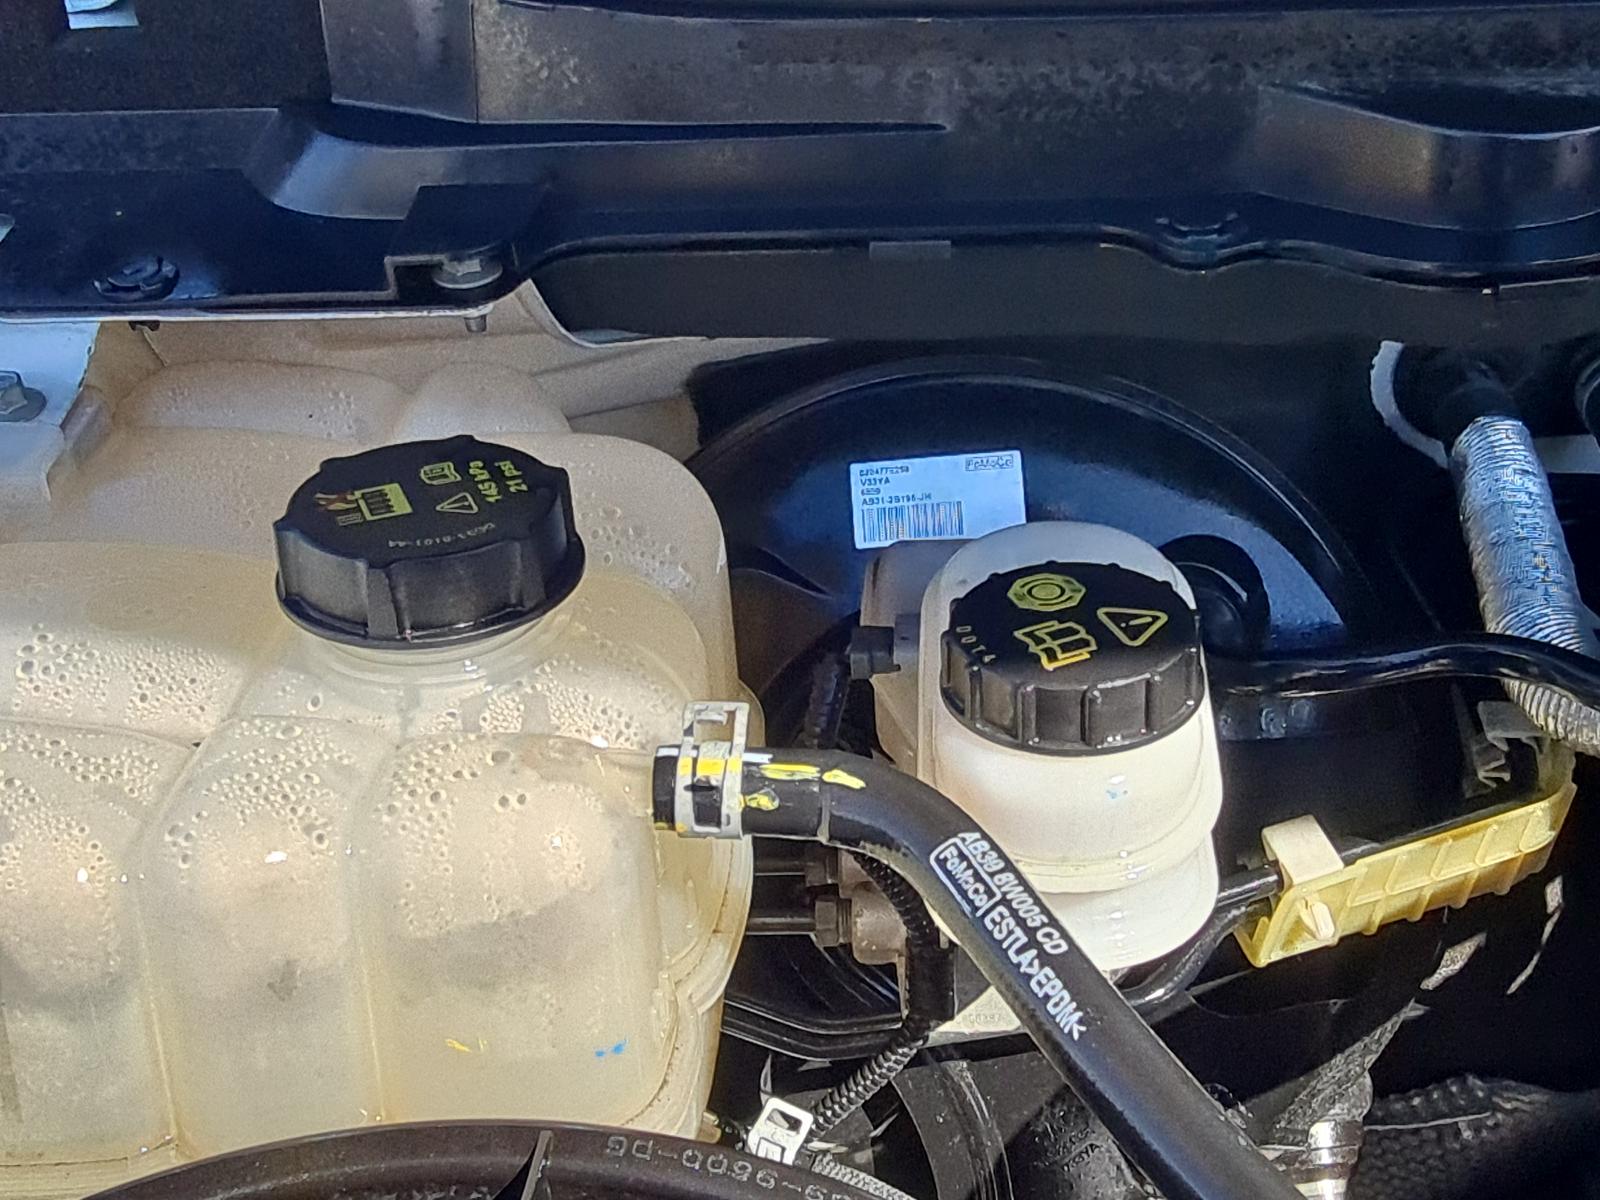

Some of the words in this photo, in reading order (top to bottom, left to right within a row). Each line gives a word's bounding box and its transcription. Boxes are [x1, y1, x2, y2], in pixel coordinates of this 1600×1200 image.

[494, 461, 522, 477] psi
[477, 481, 502, 502] 145
[505, 479, 528, 493] 21
[938, 846, 989, 908] FoMoCo
[958, 832, 1005, 873] AB39
[993, 872, 1048, 927] 8W005
[1036, 927, 1069, 955] CD
